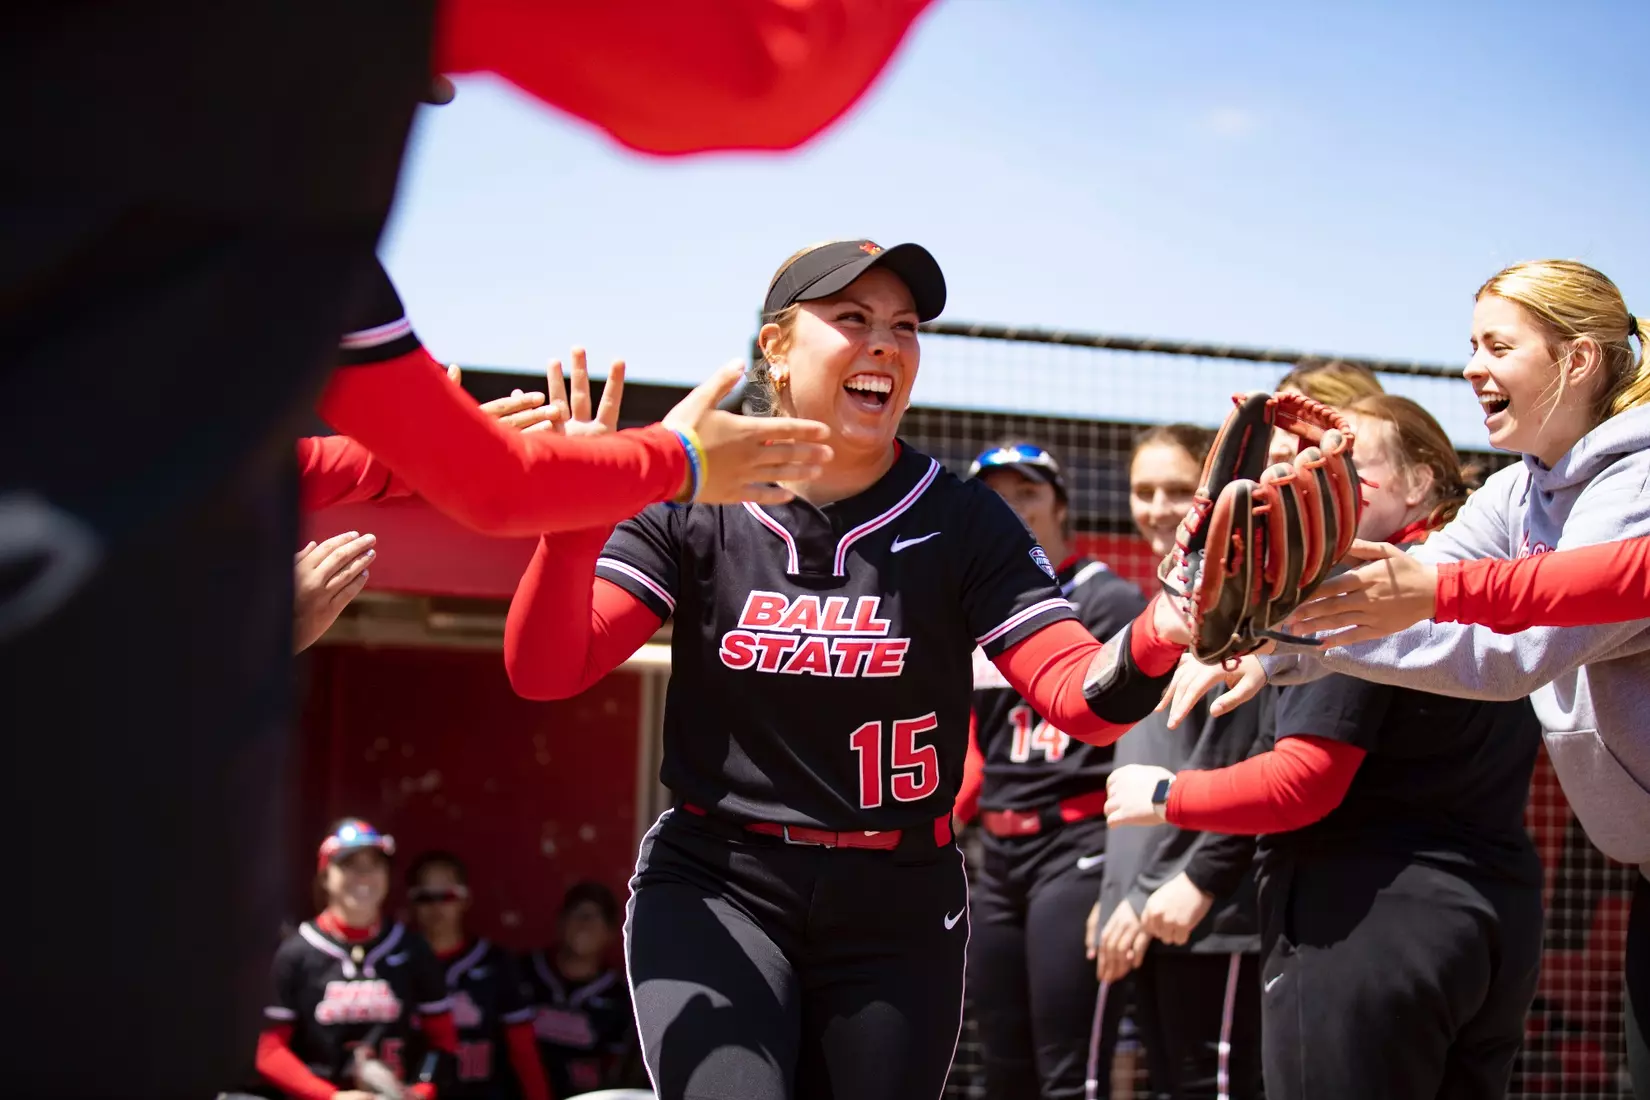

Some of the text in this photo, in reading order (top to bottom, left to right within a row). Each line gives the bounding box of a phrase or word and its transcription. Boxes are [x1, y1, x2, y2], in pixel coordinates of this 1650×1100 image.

[738, 590, 891, 635] BALL
[719, 630, 911, 678] STATE
[850, 711, 940, 809] 15
[1008, 705, 1070, 763] 14
